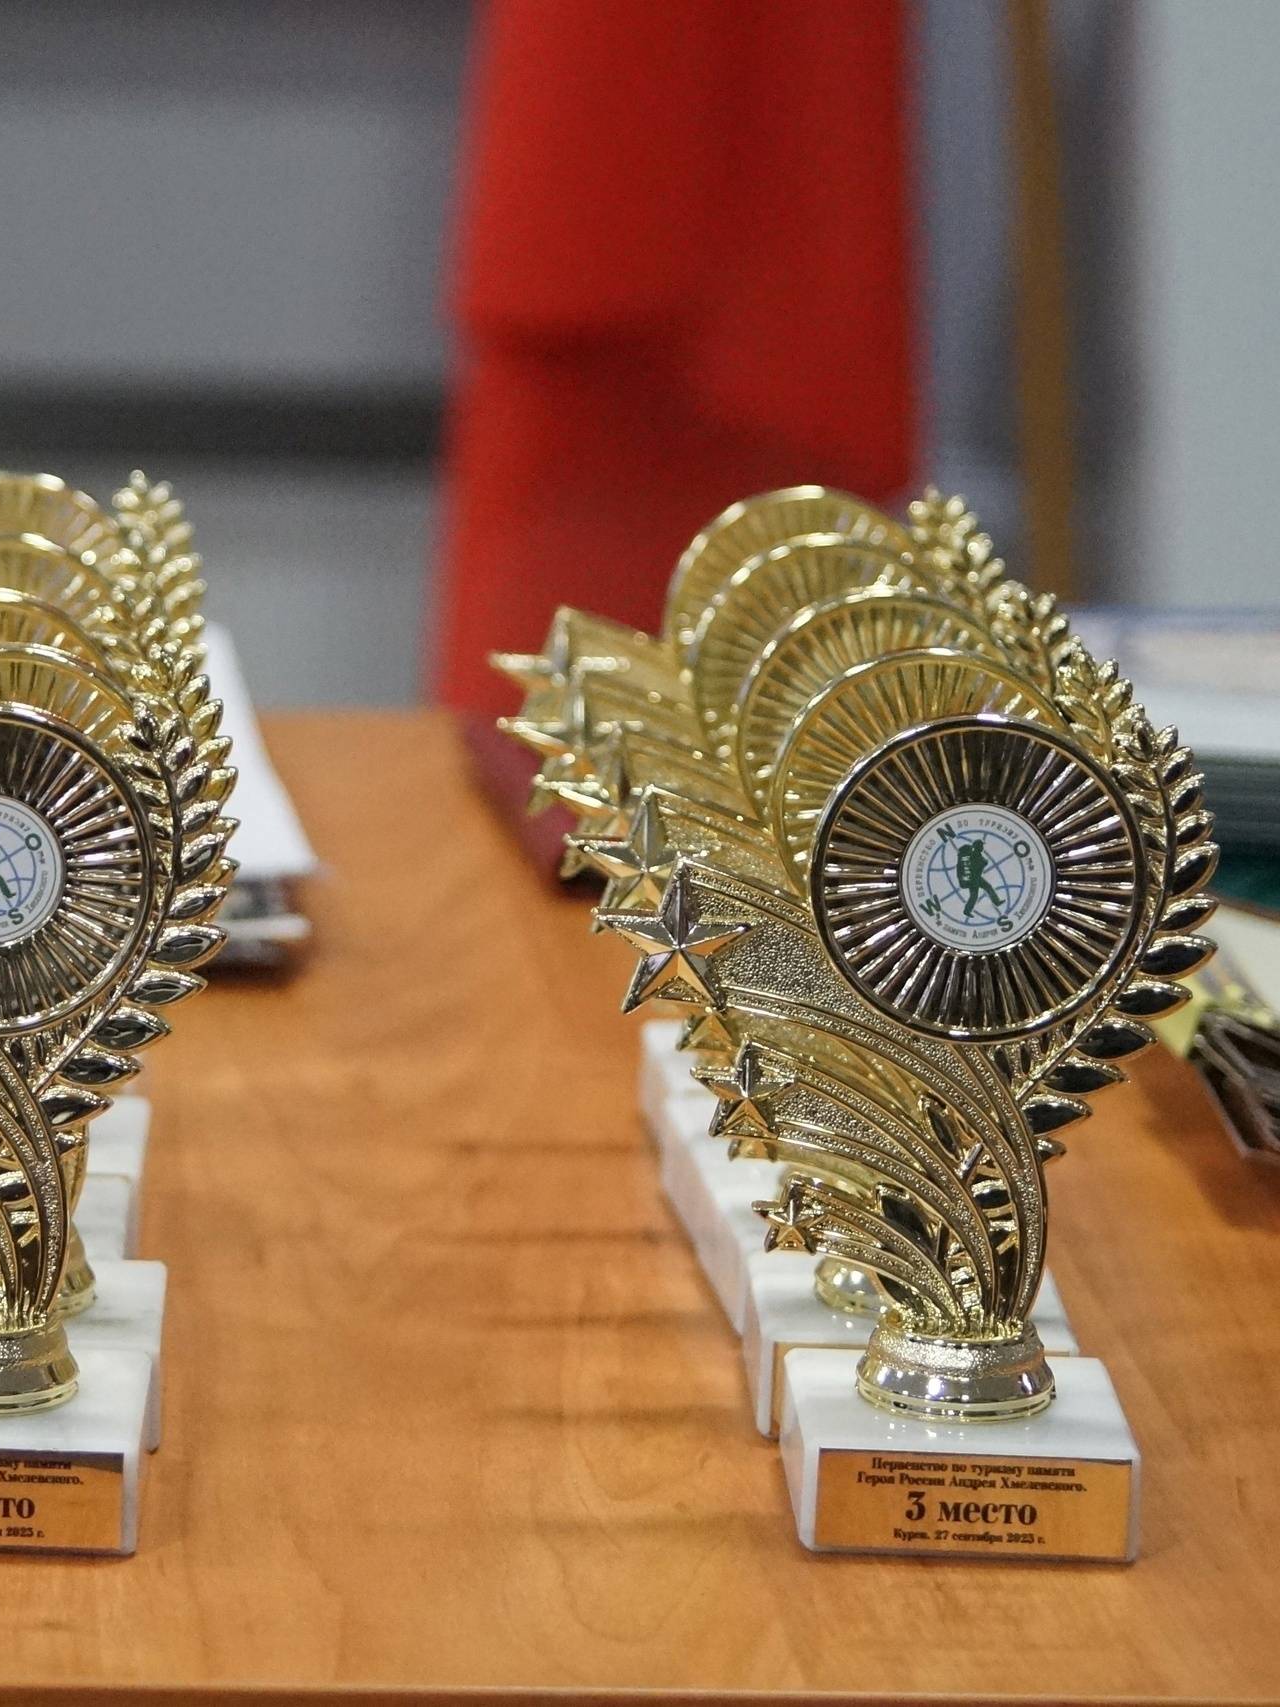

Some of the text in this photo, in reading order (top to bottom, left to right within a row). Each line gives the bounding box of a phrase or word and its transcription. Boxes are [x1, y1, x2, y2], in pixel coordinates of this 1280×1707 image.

[936, 822, 956, 843] N
[919, 894, 942, 917] W
[8, 908, 24, 925] S
[997, 915, 1014, 932] S
[24, 1458, 72, 1470] памяти
[872, 1458, 1075, 1478] Первенство по туризму памяти
[857, 1472, 894, 1486] Героя
[900, 1473, 945, 1486] России
[949, 1476, 996, 1491] Андрея
[905, 1492, 1038, 1525] 3 место
[934, 1530, 948, 1540] 27
[952, 1531, 1002, 1544] сентября
